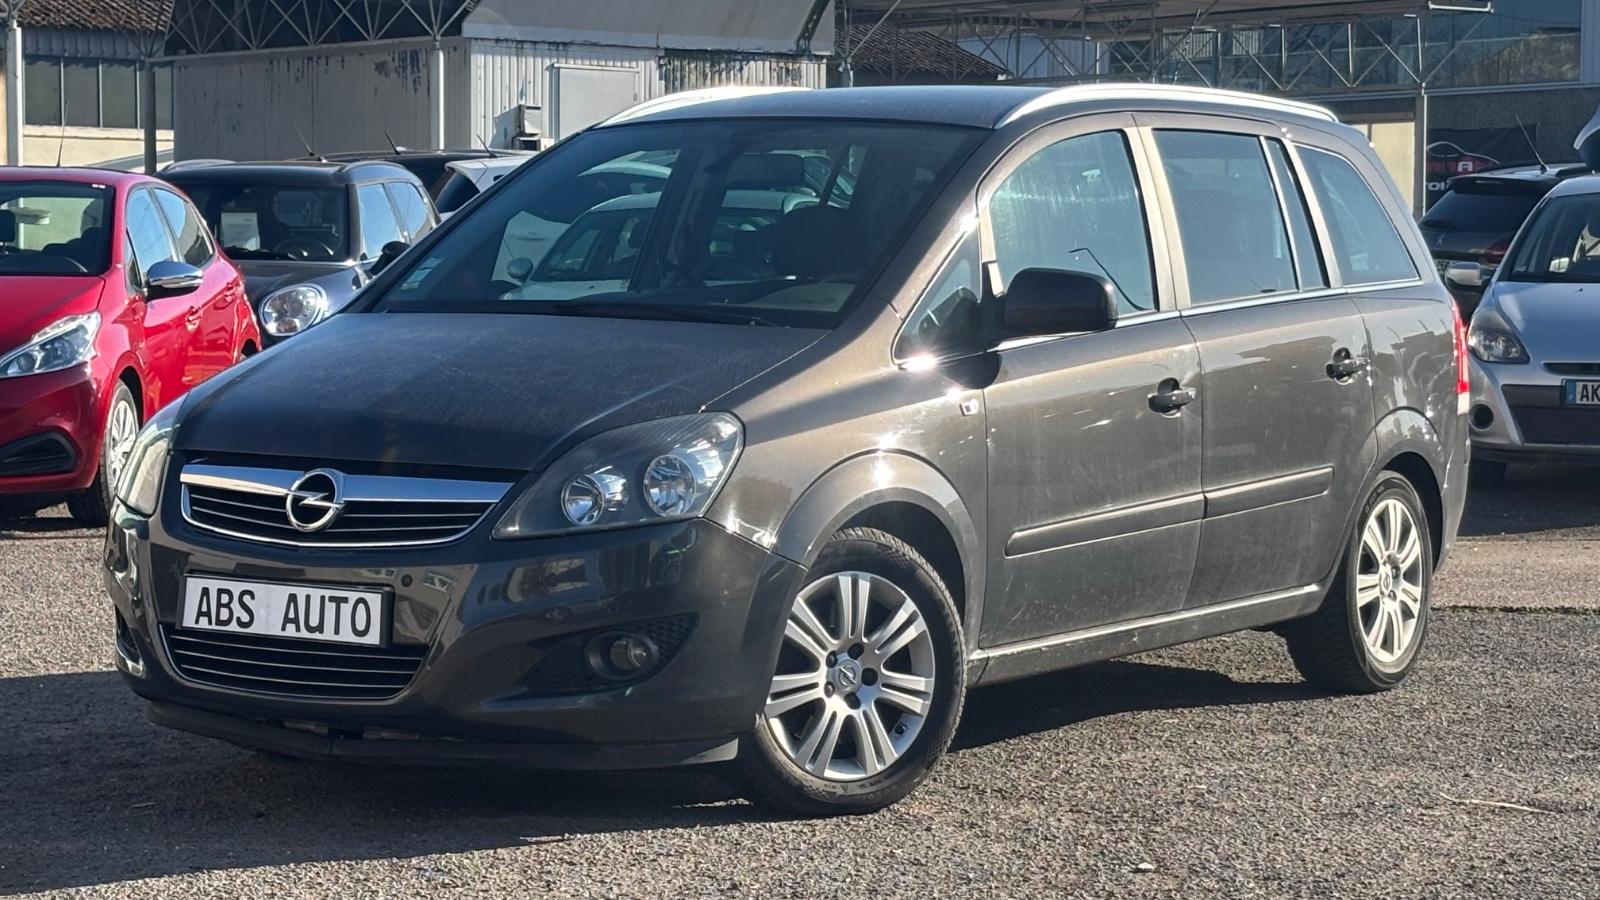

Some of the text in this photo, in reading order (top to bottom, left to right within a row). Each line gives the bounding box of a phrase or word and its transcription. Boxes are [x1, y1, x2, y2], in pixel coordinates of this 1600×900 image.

[1580, 383, 1600, 402] AK
[194, 586, 372, 638] ABS AUTO
